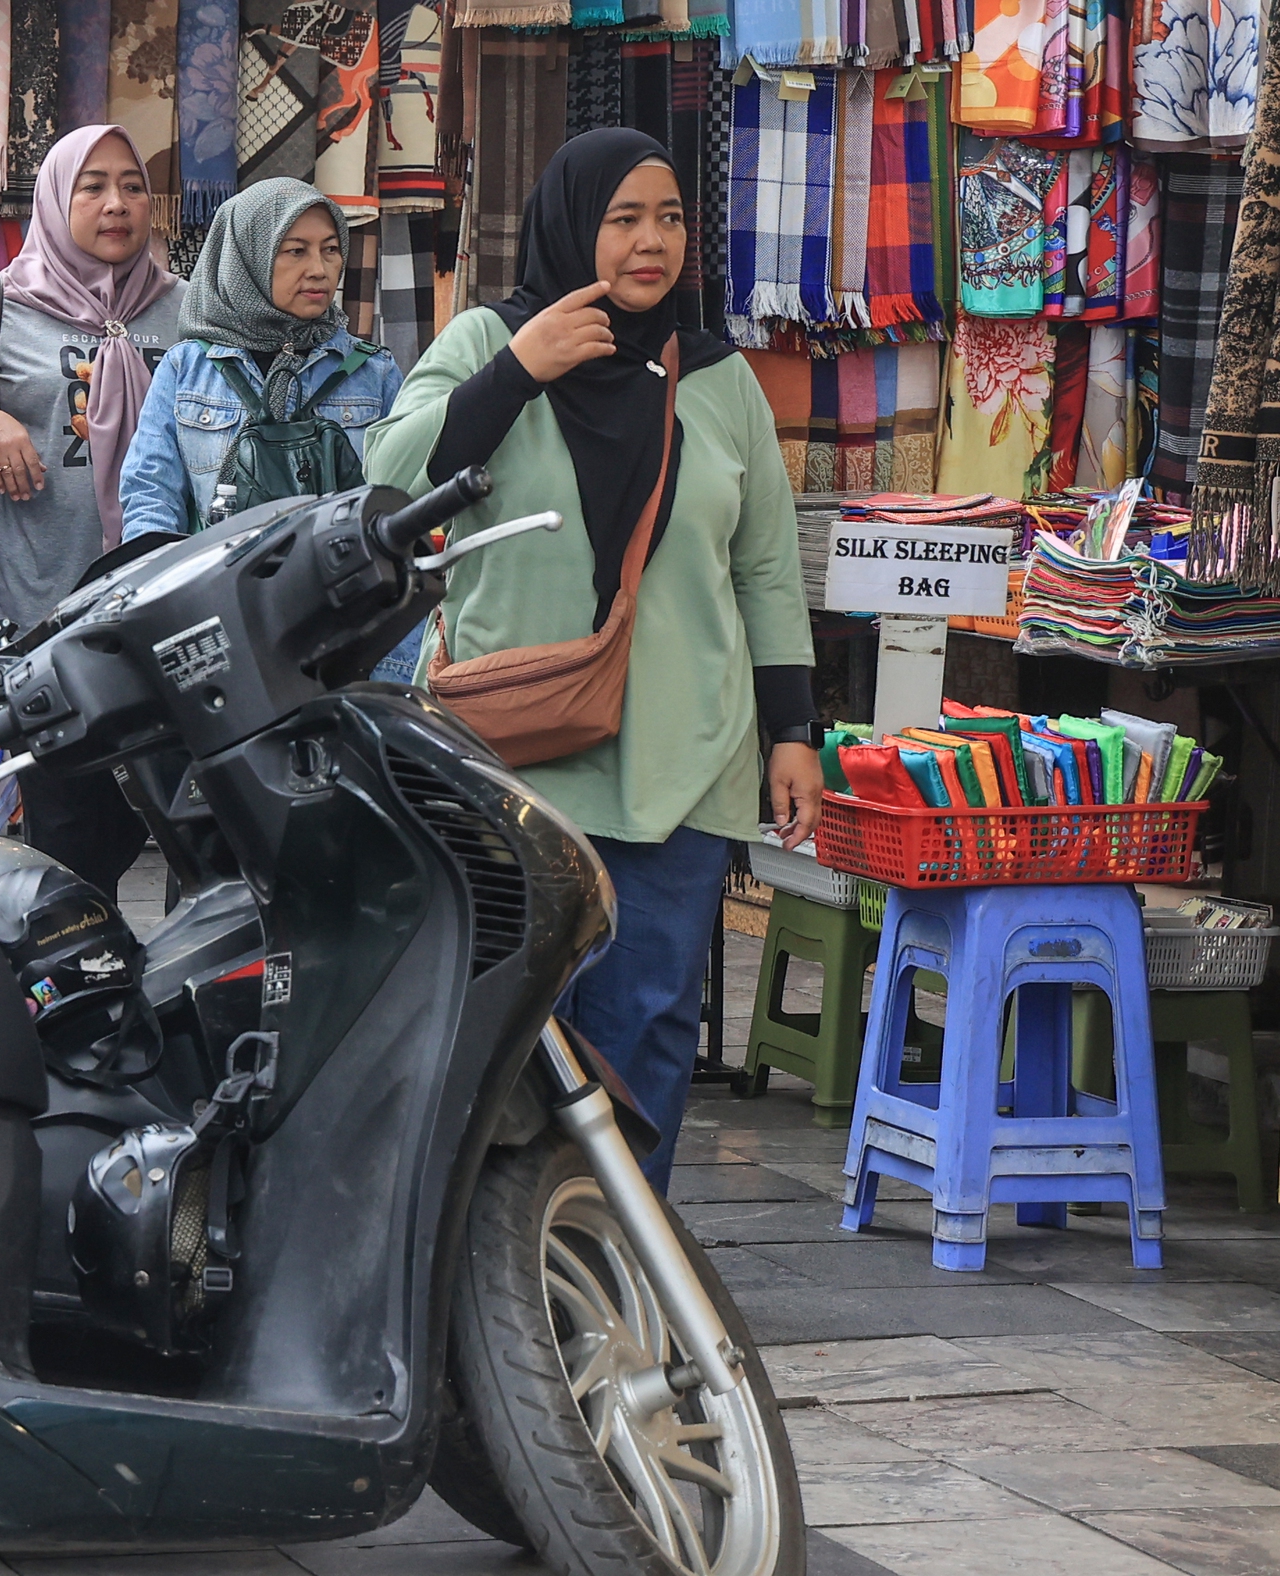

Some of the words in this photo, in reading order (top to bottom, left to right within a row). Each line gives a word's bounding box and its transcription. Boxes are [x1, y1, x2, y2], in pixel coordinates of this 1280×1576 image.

[835, 537, 889, 559] SILK
[894, 540, 1008, 564] SLEEPING
[898, 576, 950, 598] BAG
[61, 922, 80, 936] safety
